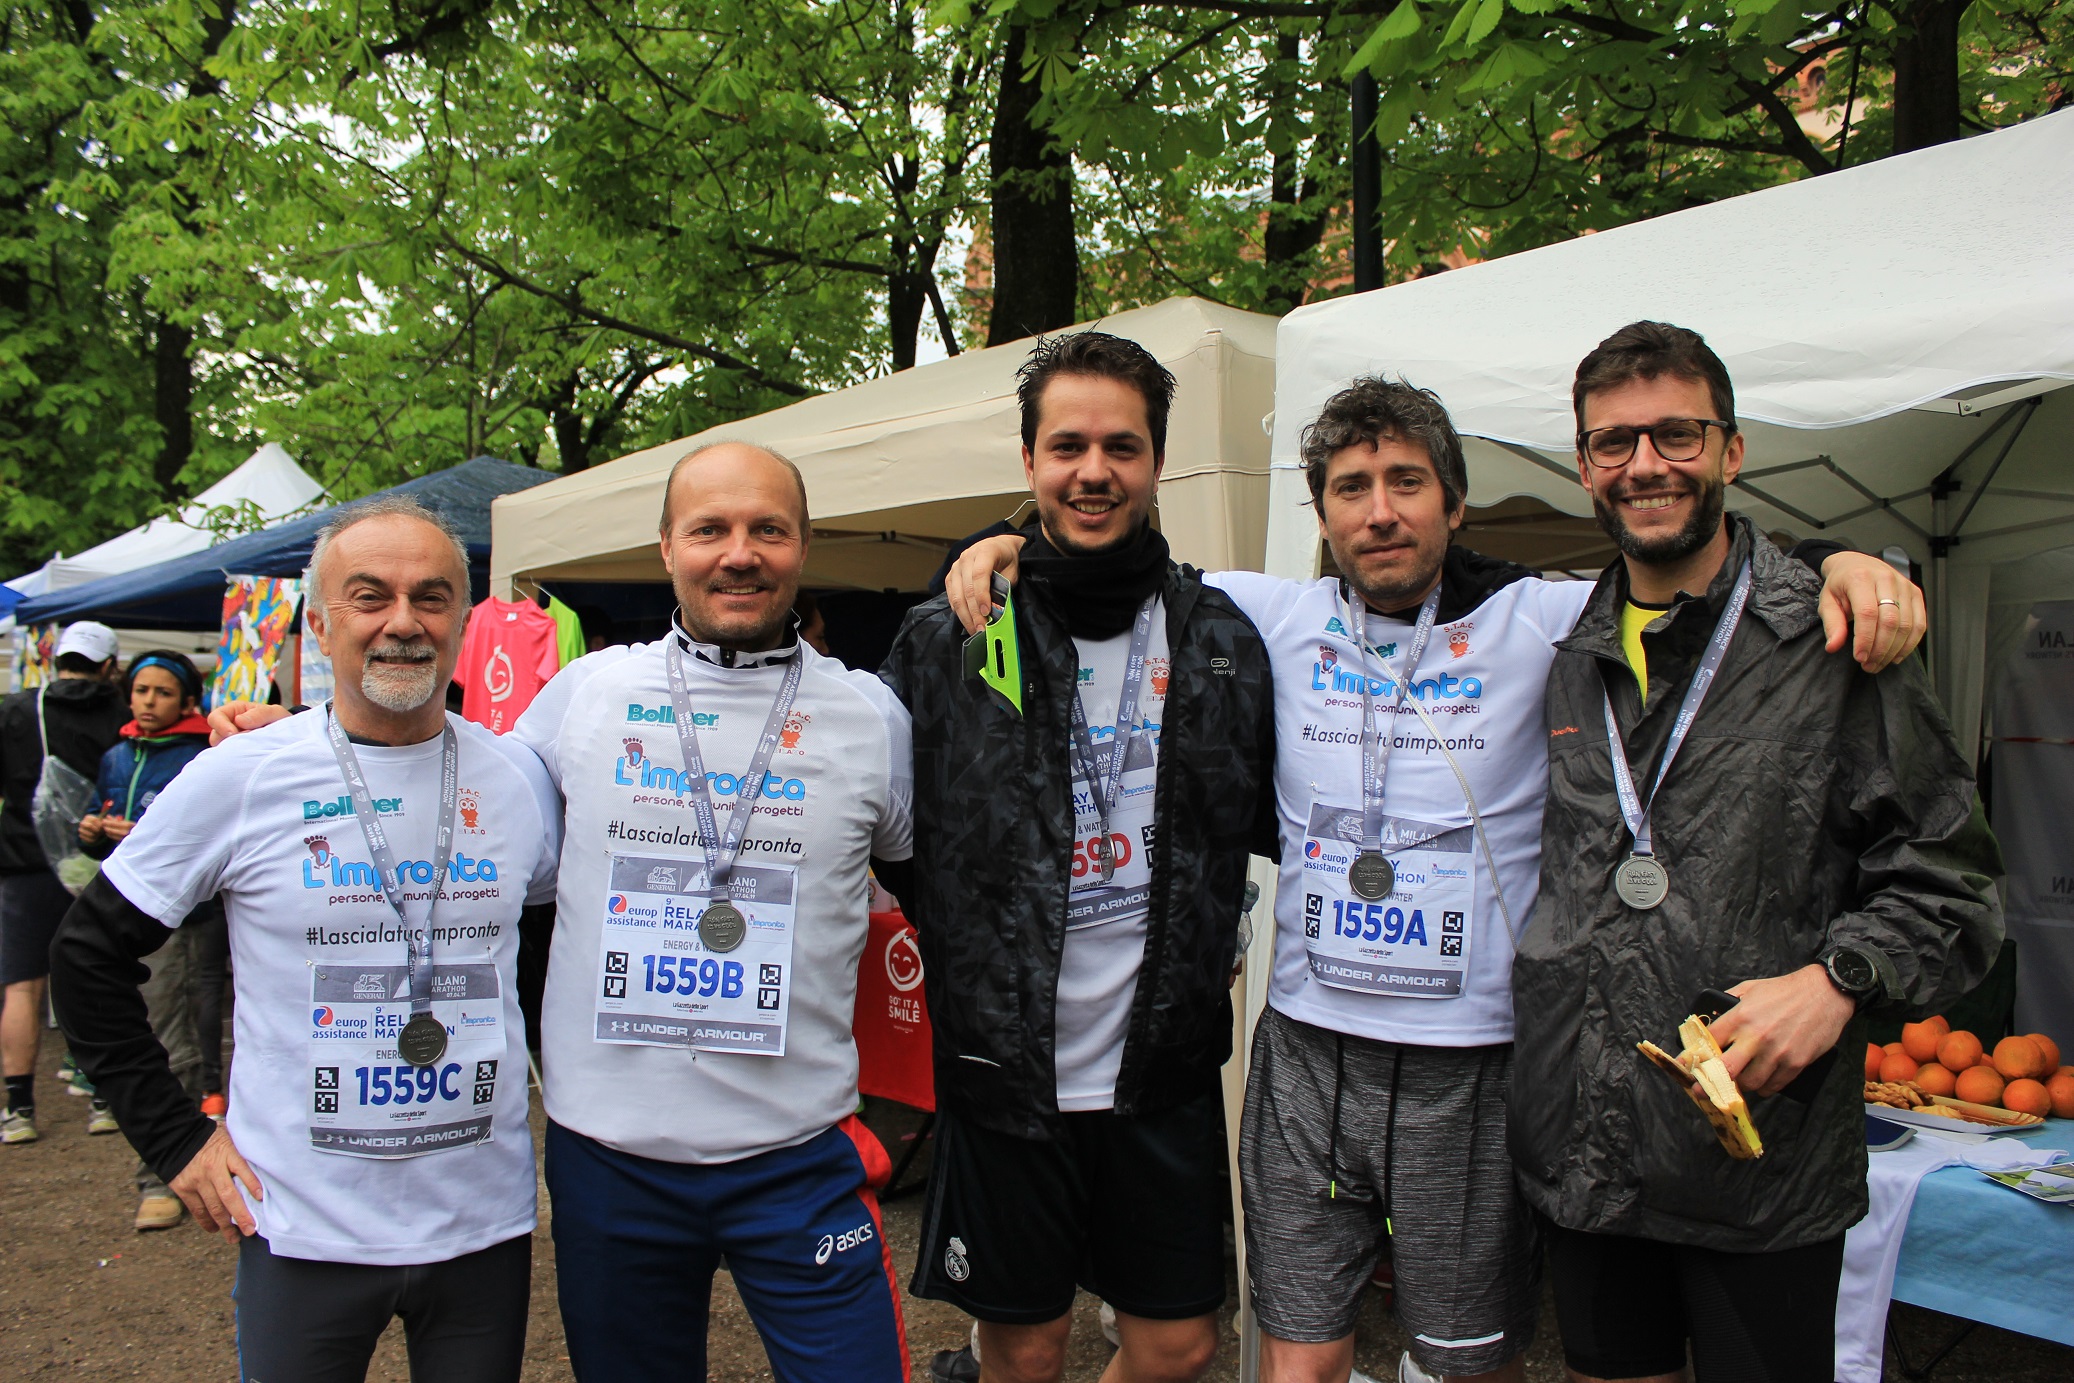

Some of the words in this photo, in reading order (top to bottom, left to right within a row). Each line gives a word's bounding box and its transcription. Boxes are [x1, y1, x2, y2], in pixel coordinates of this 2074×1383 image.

[1732, 585, 1743, 608] RELAY
[1736, 589, 1749, 611] EUROP
[1444, 622, 1474, 632] S.T.A.C.
[1715, 607, 1736, 645] MARATHON
[1719, 611, 1740, 651] ASSISTANCE
[1410, 623, 1423, 656] MARATHON
[1413, 626, 1428, 662] ASSISTANCE
[776, 681, 791, 713] MARATHON
[780, 684, 797, 718] ASSISTANCE
[1432, 704, 1480, 715] progetti
[1111, 740, 1122, 780] ASSISTANCE
[1114, 744, 1125, 781] MARATHON
[1614, 755, 1625, 793] ASSISTANCE
[1619, 756, 1632, 792] MARATHON
[633, 794, 685, 808] persone,
[751, 802, 804, 817] progetti
[1622, 795, 1632, 816] EUROP
[1628, 794, 1639, 815] RELAY
[696, 798, 708, 838] ASSISTANCE
[702, 801, 715, 839] MARATHON
[1078, 825, 1083, 834] &
[704, 838, 714, 861] EUROP
[1322, 853, 1347, 865] europ
[1304, 861, 1346, 875] assistance
[646, 884, 676, 892] GENERALI
[728, 876, 757, 887] LANO
[329, 893, 386, 906] persone,
[452, 887, 500, 902] progetti
[1066, 907, 1095, 920] DER
[1099, 891, 1150, 912] ARMOU
[1388, 892, 1413, 902] WATER
[606, 916, 657, 928] assistance
[628, 907, 658, 919] europ
[665, 906, 705, 919] RELA
[1333, 900, 1428, 947] 1559A
[663, 940, 694, 951] ENERGY
[694, 943, 700, 951] &
[431, 975, 467, 986] ILANO
[643, 954, 745, 999] 1559B
[1324, 965, 1372, 981] UNDER
[1377, 973, 1449, 987] ARMOUR
[431, 985, 466, 993] ARATHON
[889, 995, 901, 1006] GOT
[903, 1000, 911, 1009] IT
[913, 1000, 920, 1009] A
[335, 1018, 367, 1029] europ
[376, 1014, 406, 1027] REL
[888, 1006, 920, 1023] SMILE
[312, 1029, 367, 1039] assistance
[633, 1023, 688, 1036] UNDER
[693, 1028, 767, 1042] ARMOUR
[355, 1063, 462, 1106] 1559C
[348, 1135, 407, 1147] UNDER
[412, 1127, 480, 1145] ARMOUR
[837, 1223, 873, 1252] asics
